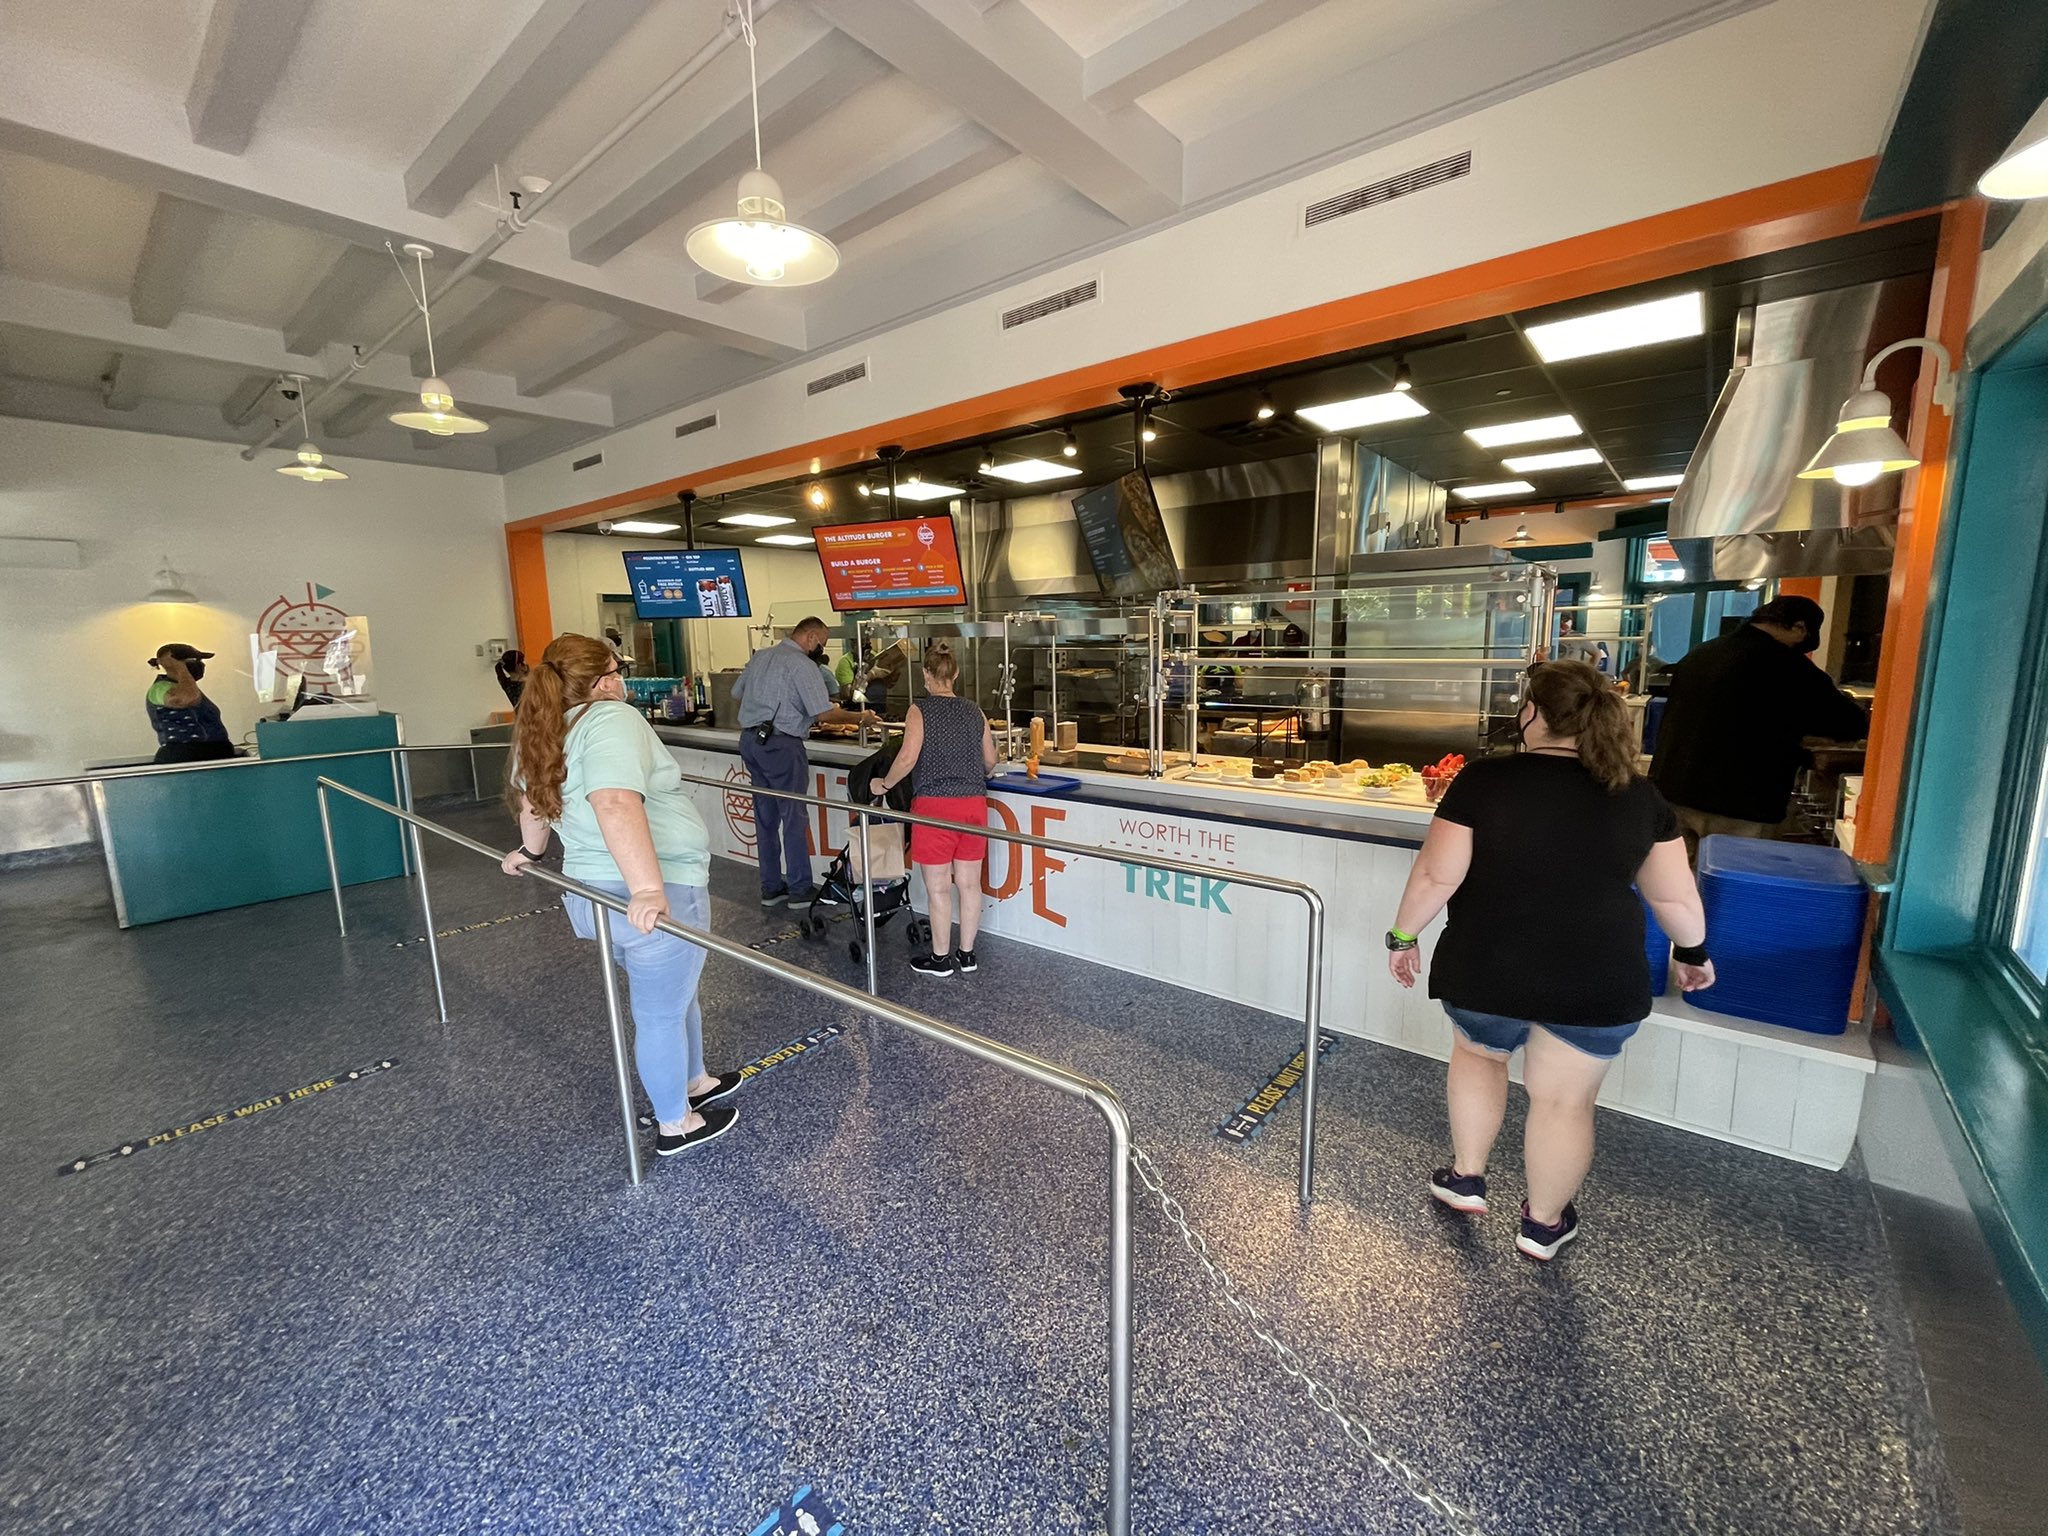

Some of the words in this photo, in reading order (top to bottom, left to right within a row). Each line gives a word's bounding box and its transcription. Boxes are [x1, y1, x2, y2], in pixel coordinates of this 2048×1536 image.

[837, 533, 866, 542] ALTITUDE
[867, 531, 893, 540] BURGER
[830, 560, 849, 568] BUILD
[856, 558, 881, 566] BURGER
[702, 594, 715, 616] ULY
[721, 585, 731, 611] TRULY
[1119, 818, 1191, 845] WORTH
[1198, 830, 1235, 853] THE
[1119, 862, 1232, 915] TREK
[756, 1043, 807, 1069] PLEASE
[739, 1065, 762, 1079] WA
[1246, 1084, 1287, 1115] PLEASE
[1272, 1067, 1302, 1088] WAIT
[148, 1113, 228, 1147] PLEASE
[234, 1095, 283, 1118] WAIT
[288, 1078, 337, 1101] HERE
